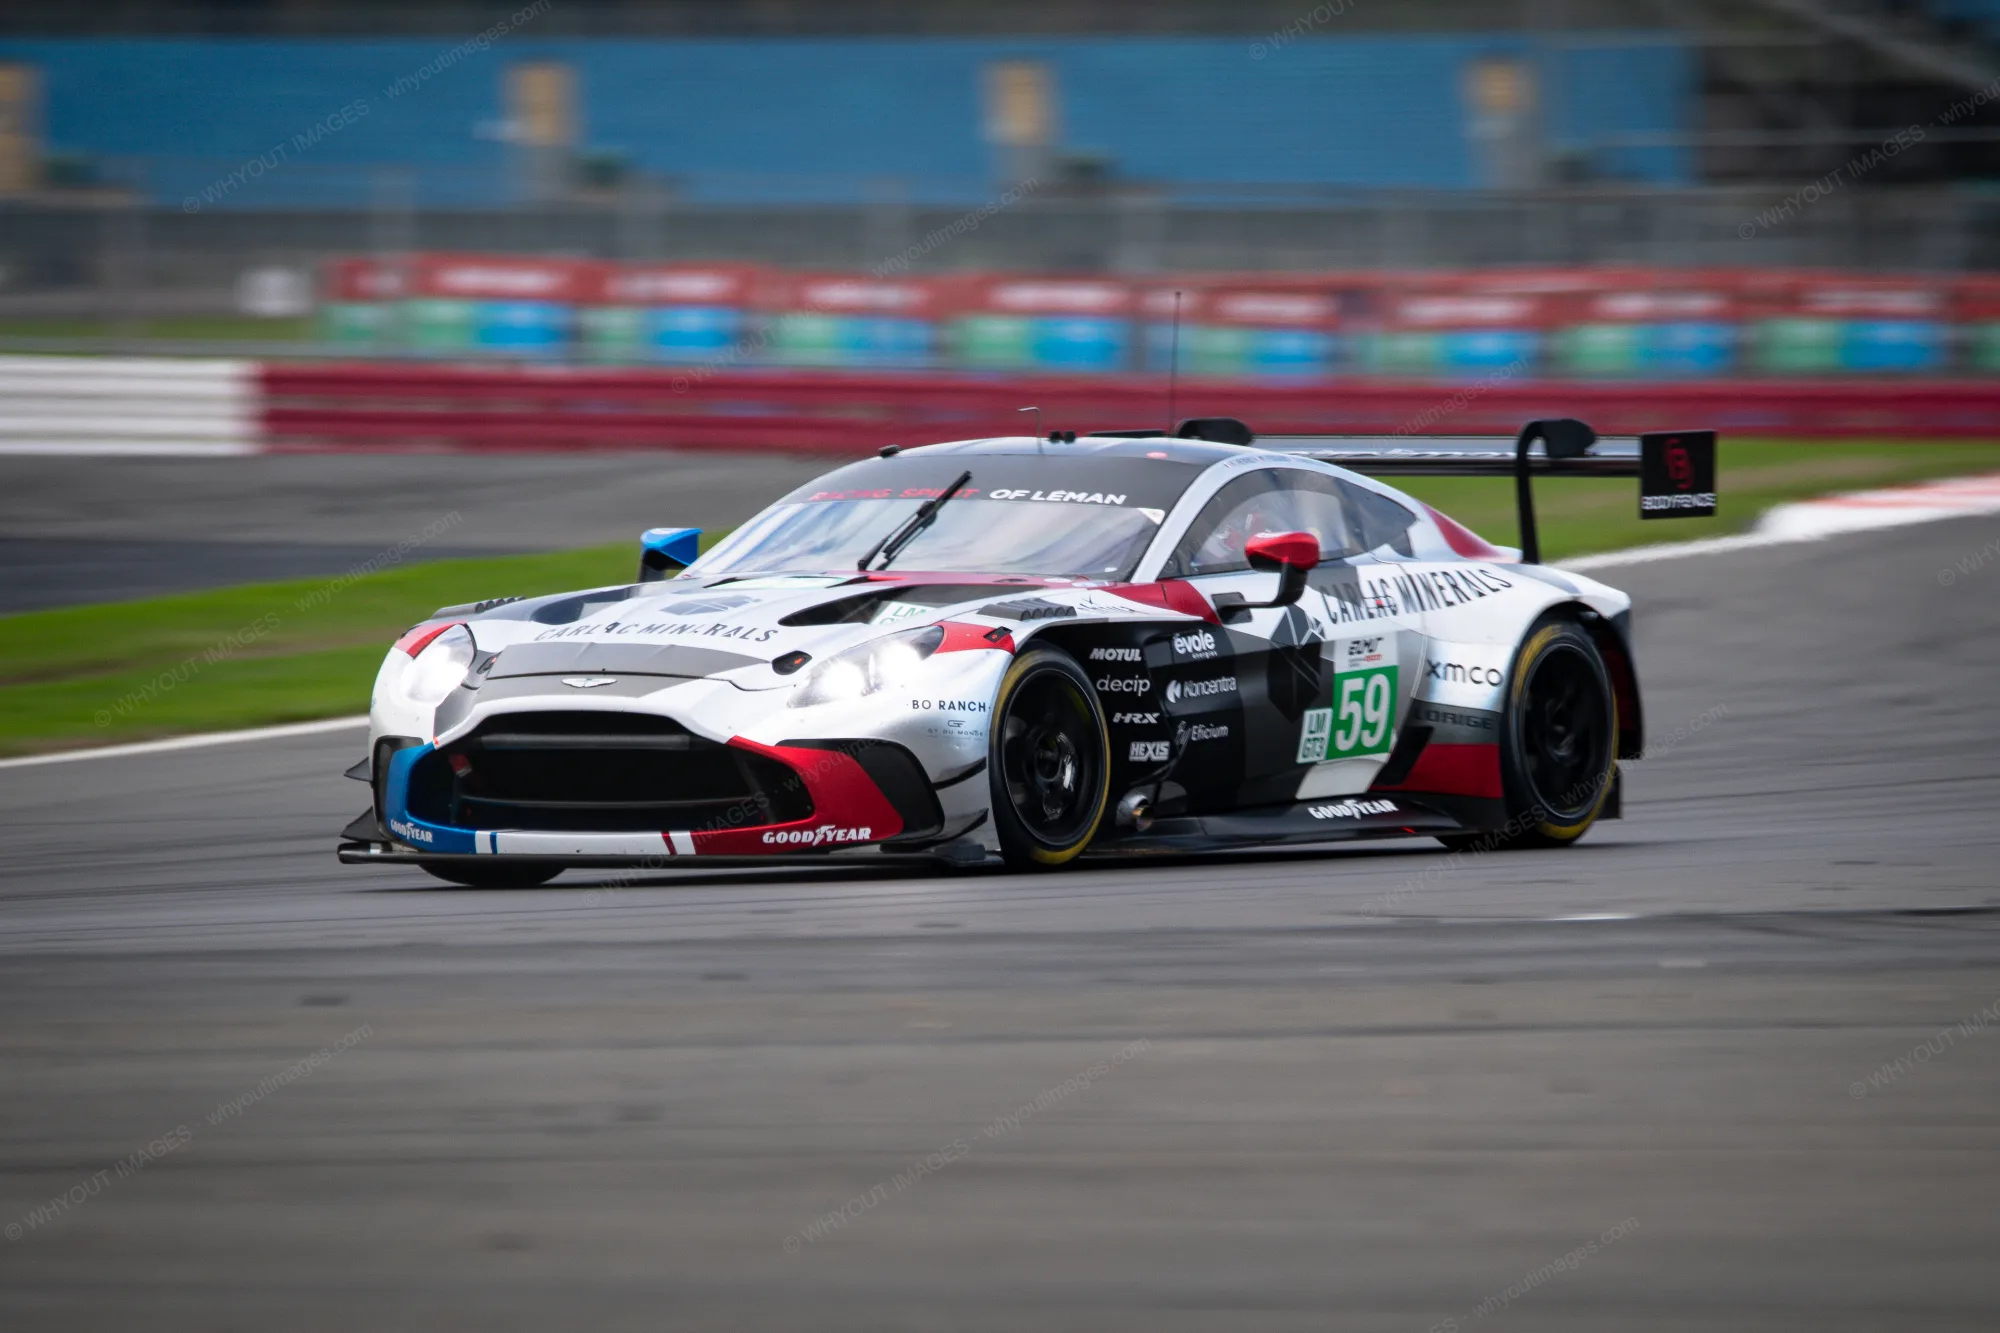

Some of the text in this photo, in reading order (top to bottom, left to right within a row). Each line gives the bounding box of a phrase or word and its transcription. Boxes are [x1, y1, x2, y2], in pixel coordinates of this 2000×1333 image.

[989, 489, 1030, 500] OF
[1392, 568, 1515, 614] MINERALS
[1089, 648, 1142, 662] MOTUL
[1425, 659, 1504, 687] xmco
[1096, 674, 1151, 697] decip
[912, 699, 986, 712] BO RANCH
[1335, 673, 1391, 751] 59
[1112, 713, 1160, 724] HRX
[1129, 741, 1170, 761] HEXIS
[1308, 799, 1400, 820] GOODYEAR
[762, 825, 872, 847] GOODYEAR
